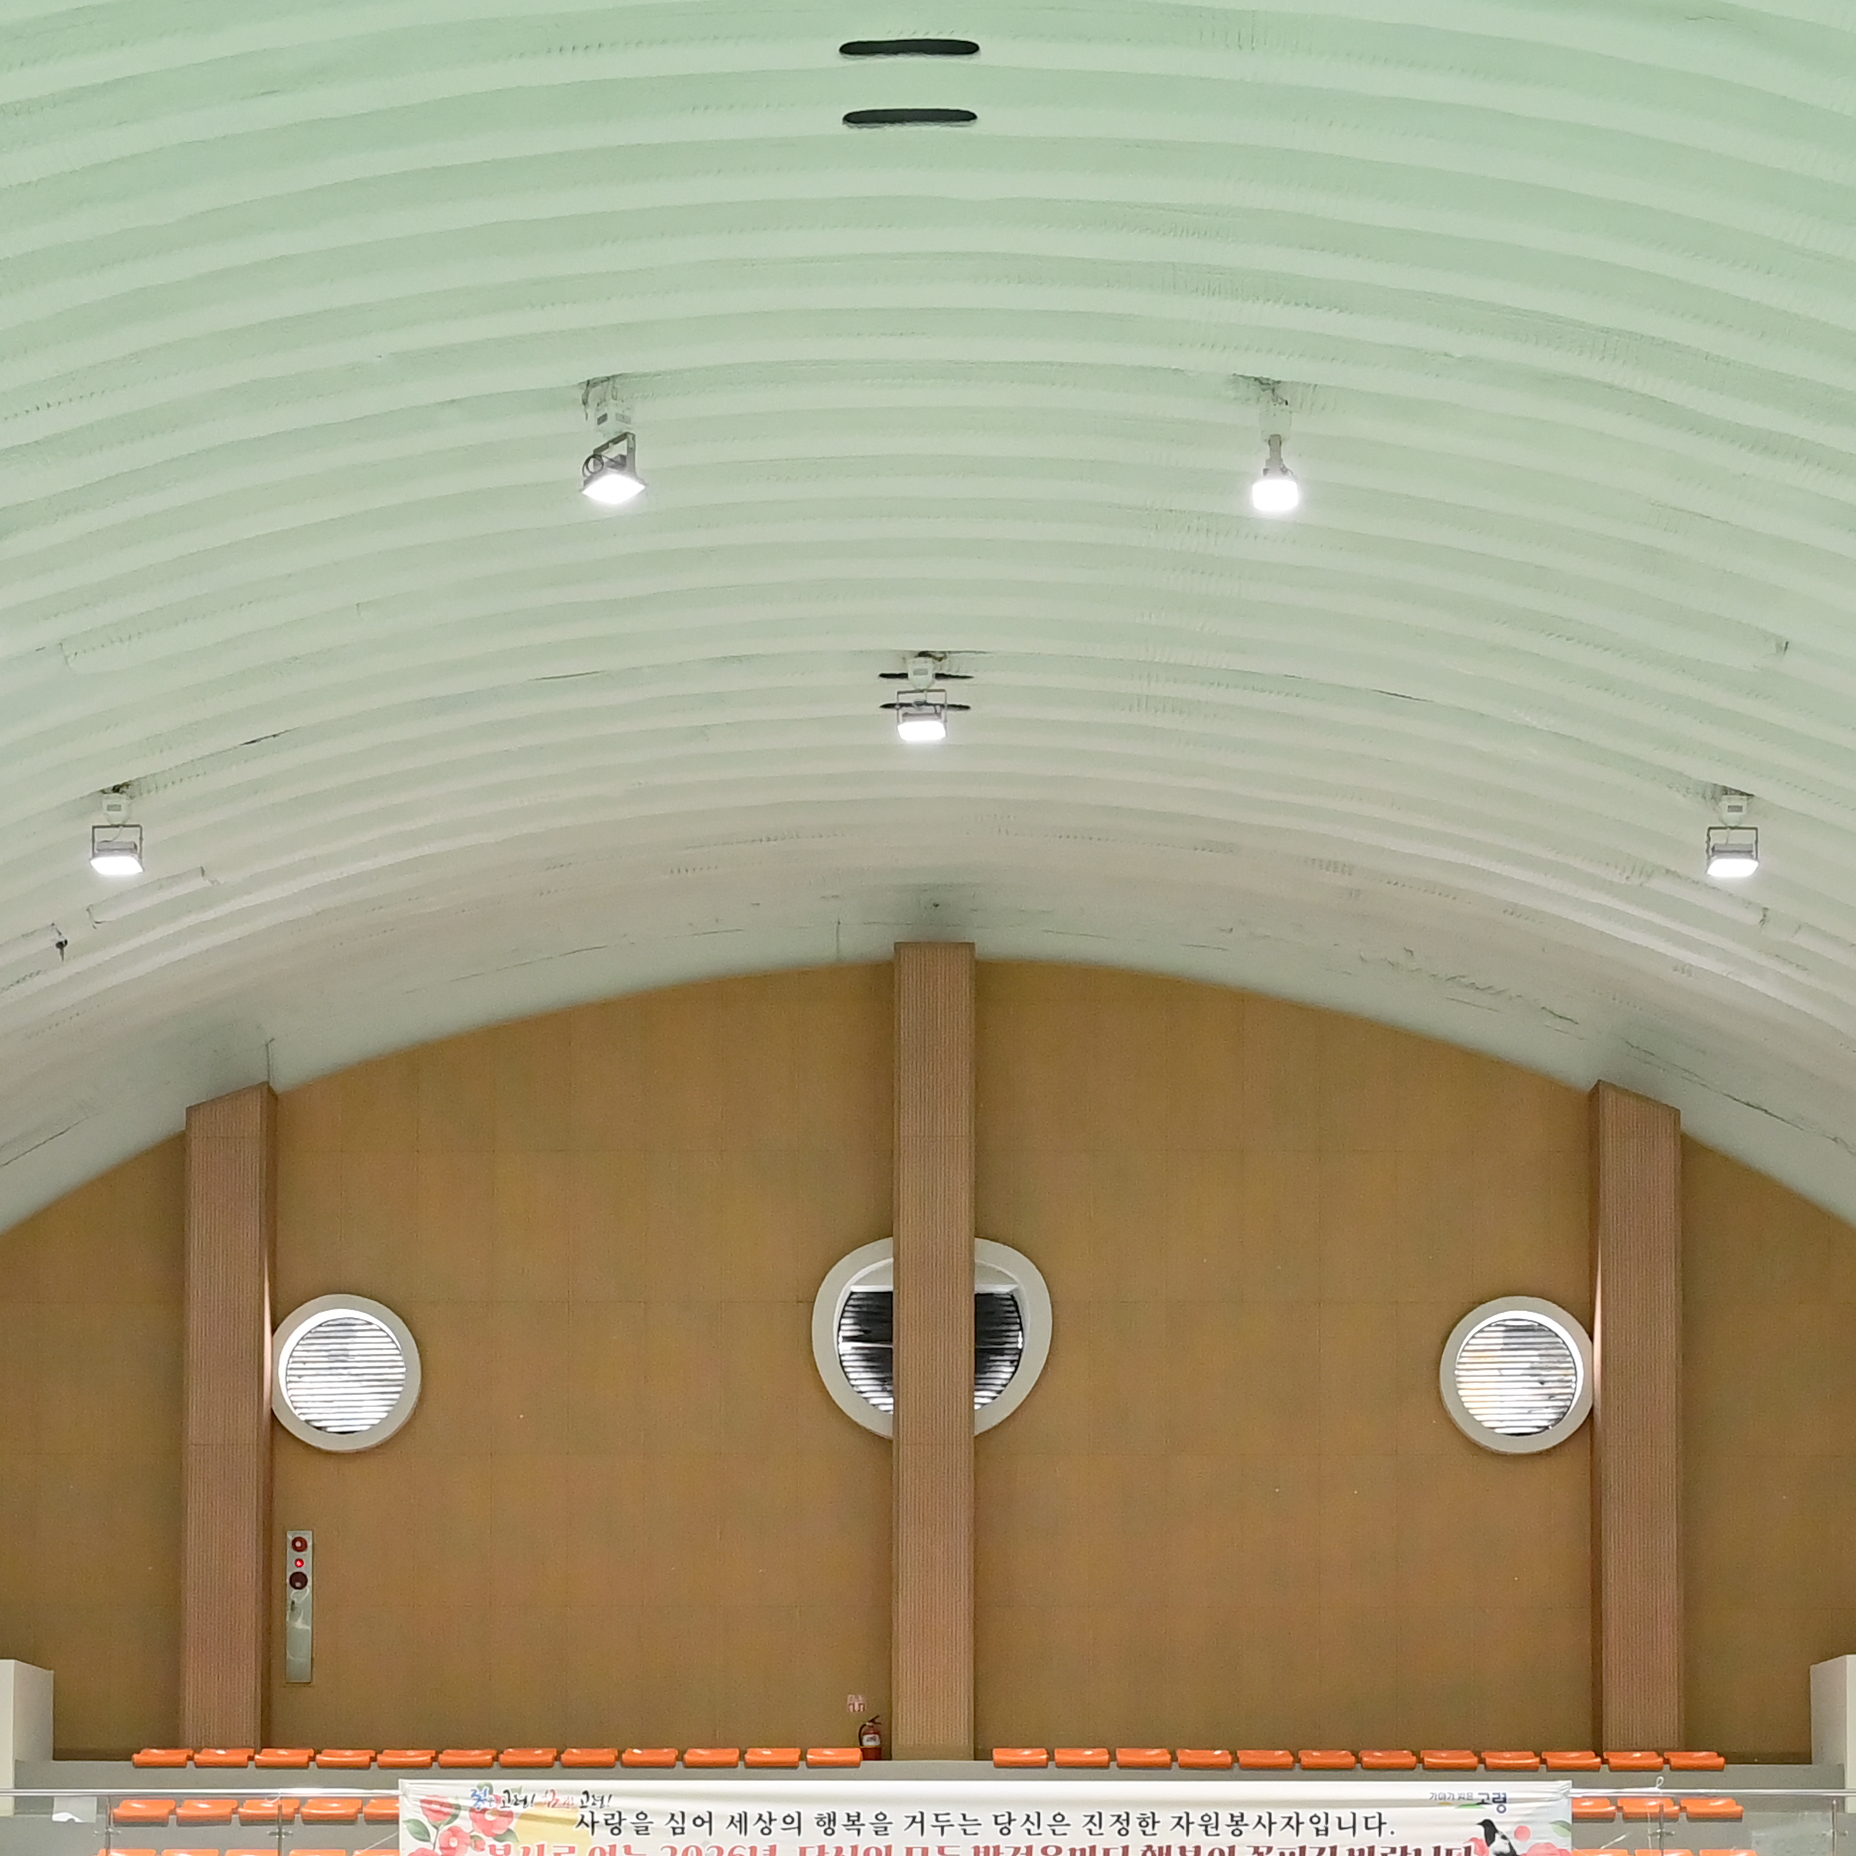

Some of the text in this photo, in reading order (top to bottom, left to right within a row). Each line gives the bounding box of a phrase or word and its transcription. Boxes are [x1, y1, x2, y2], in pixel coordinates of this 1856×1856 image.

[1477, 1792, 1507, 1814] 고령
[575, 1810, 1396, 1837] 사랑을 심어 세상의 행복을 거두는 당신은 진정한 자원봉사자입니다.
